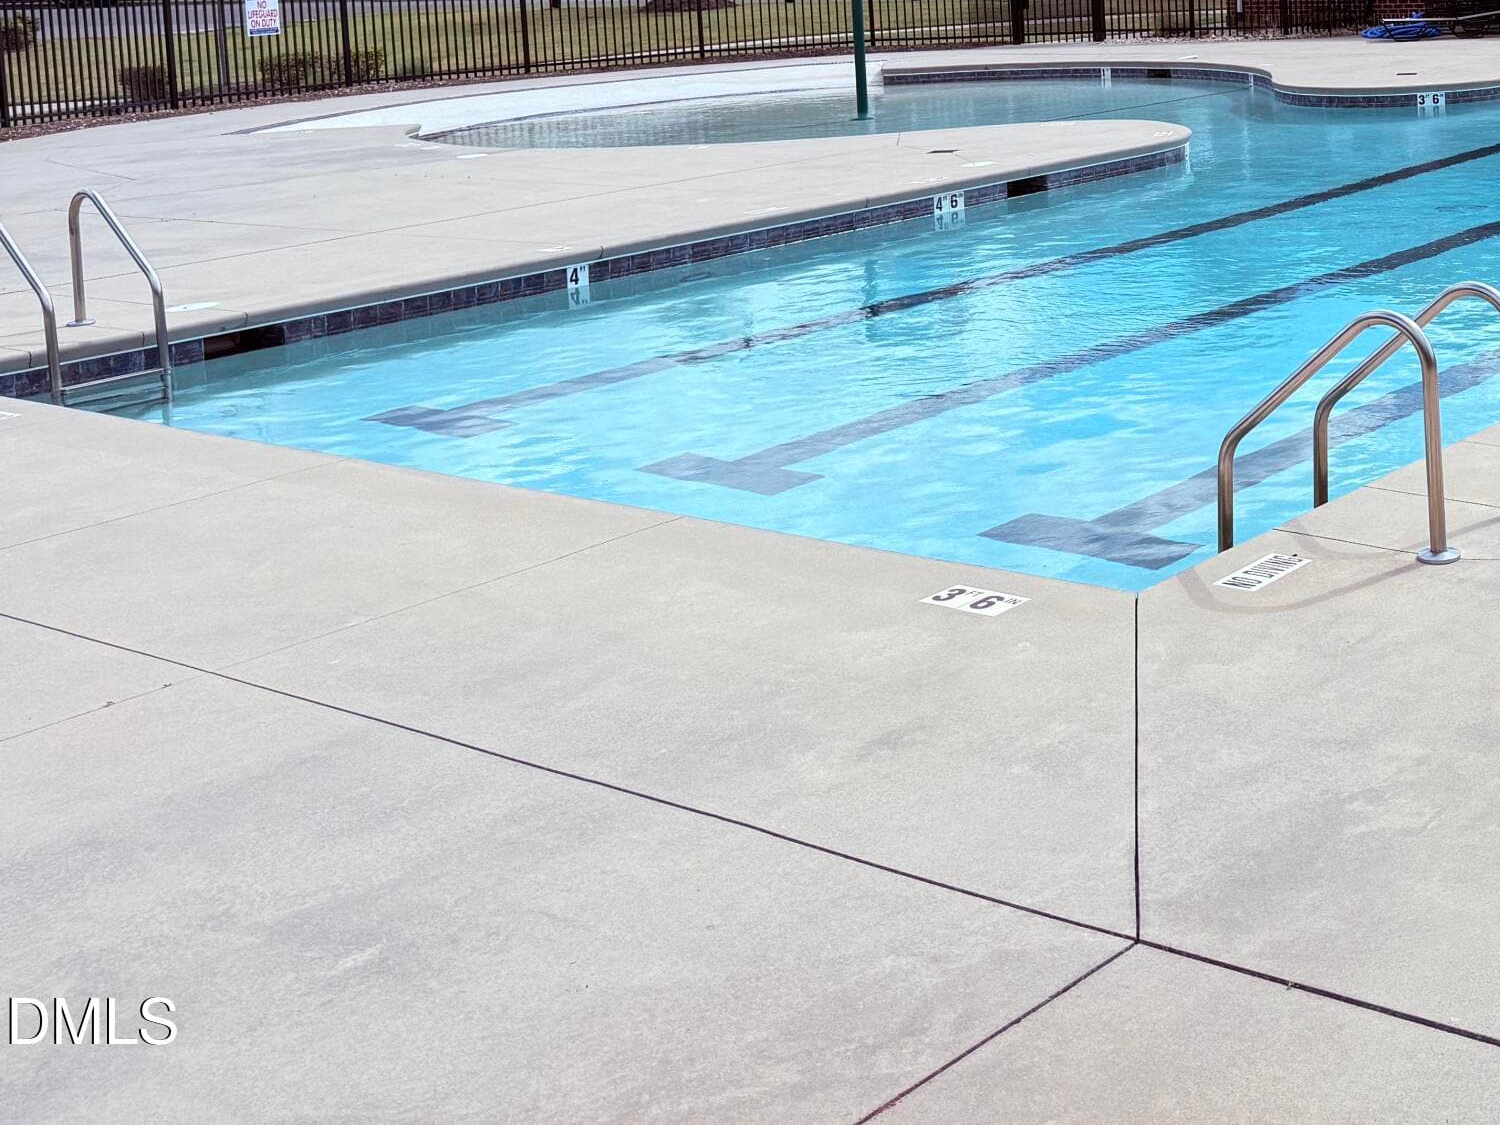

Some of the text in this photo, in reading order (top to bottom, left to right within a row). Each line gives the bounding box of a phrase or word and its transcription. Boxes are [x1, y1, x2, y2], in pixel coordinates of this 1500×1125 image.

[256, 1, 267, 9] NO
[248, 10, 277, 19] LIFEGUARD
[250, 19, 276, 28] ON DUTY
[1222, 555, 1303, 589] NO DIVING
[932, 588, 967, 602] 3
[969, 595, 1005, 610] 6
